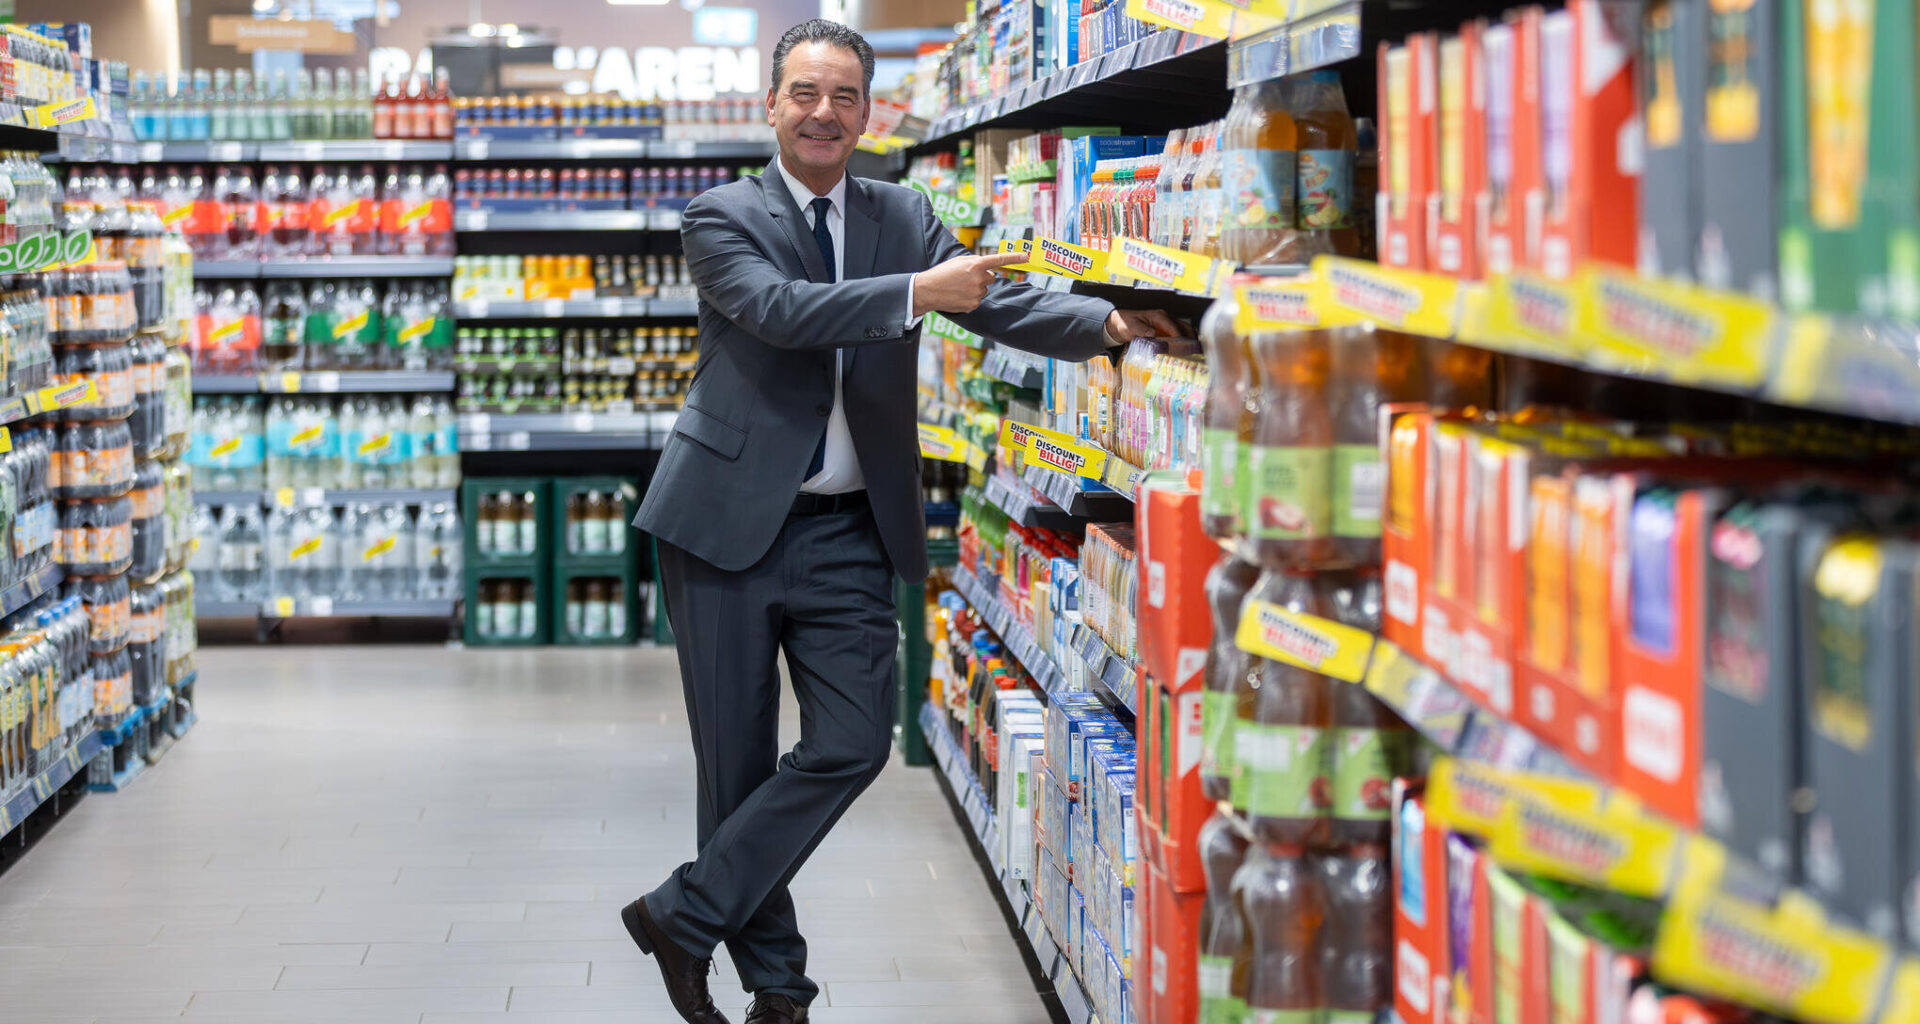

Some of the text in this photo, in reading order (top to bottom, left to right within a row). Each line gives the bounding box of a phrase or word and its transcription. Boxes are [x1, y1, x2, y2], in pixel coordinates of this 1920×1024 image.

[934, 193, 970, 218] BIO
[1042, 240, 1091, 265] DISCOUNT-
[1045, 250, 1083, 273] BILLIG!
[1124, 242, 1184, 272] DISCOUNT-
[1128, 254, 1174, 281] BILLIG!
[933, 315, 969, 340] BIO
[1036, 439, 1083, 463] DISCOUNT-
[1040, 449, 1076, 471] BILLIG!
